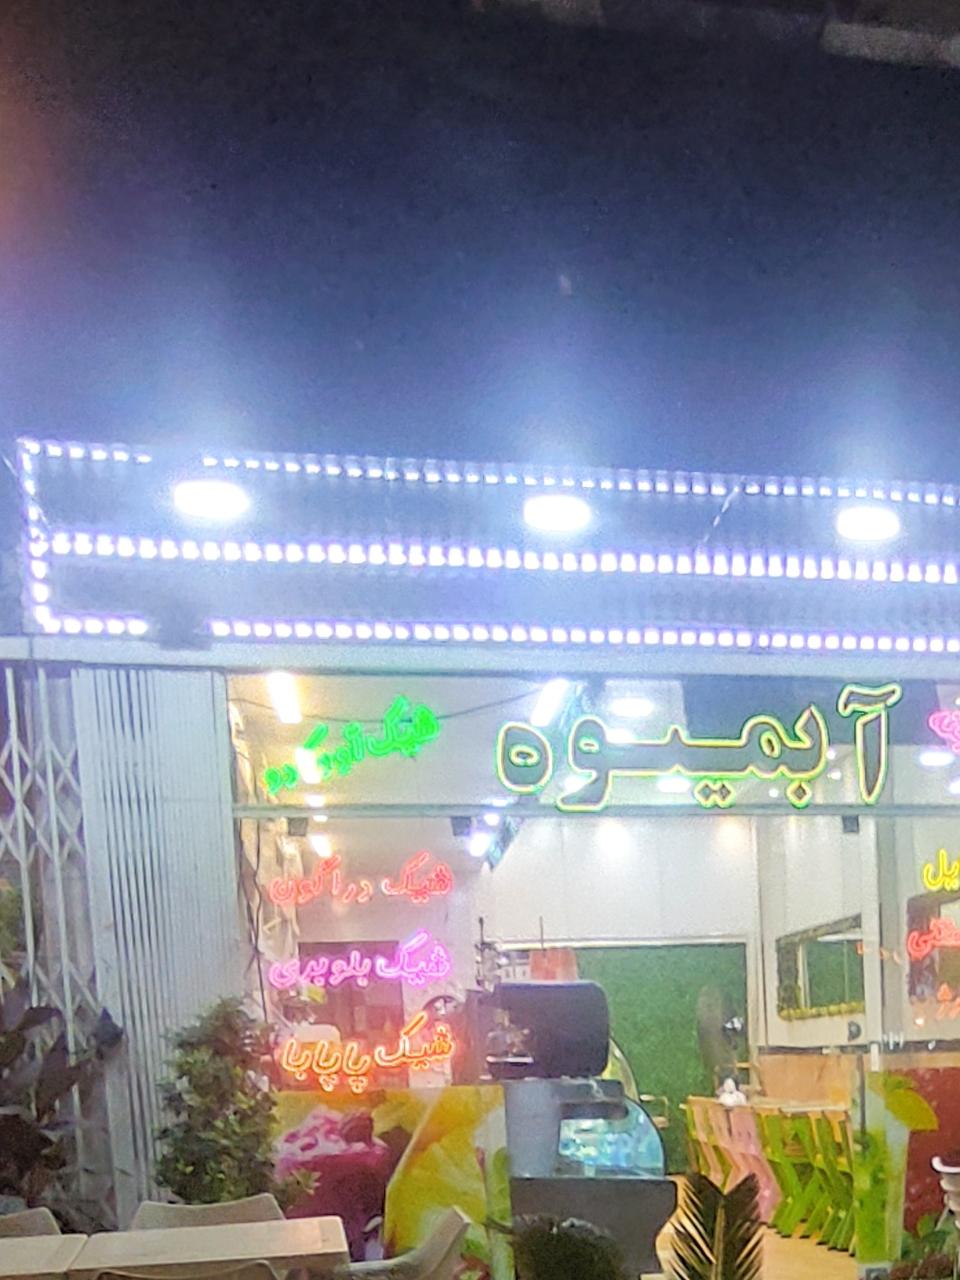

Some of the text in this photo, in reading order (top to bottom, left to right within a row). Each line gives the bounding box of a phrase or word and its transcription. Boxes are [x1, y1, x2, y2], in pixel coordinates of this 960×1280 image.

[497, 683, 902, 811] آبمیوه
[268, 852, 455, 904] شیک دراگون
[269, 930, 451, 989] شیک بلوبری
[374, 1011, 455, 1070] شیک
